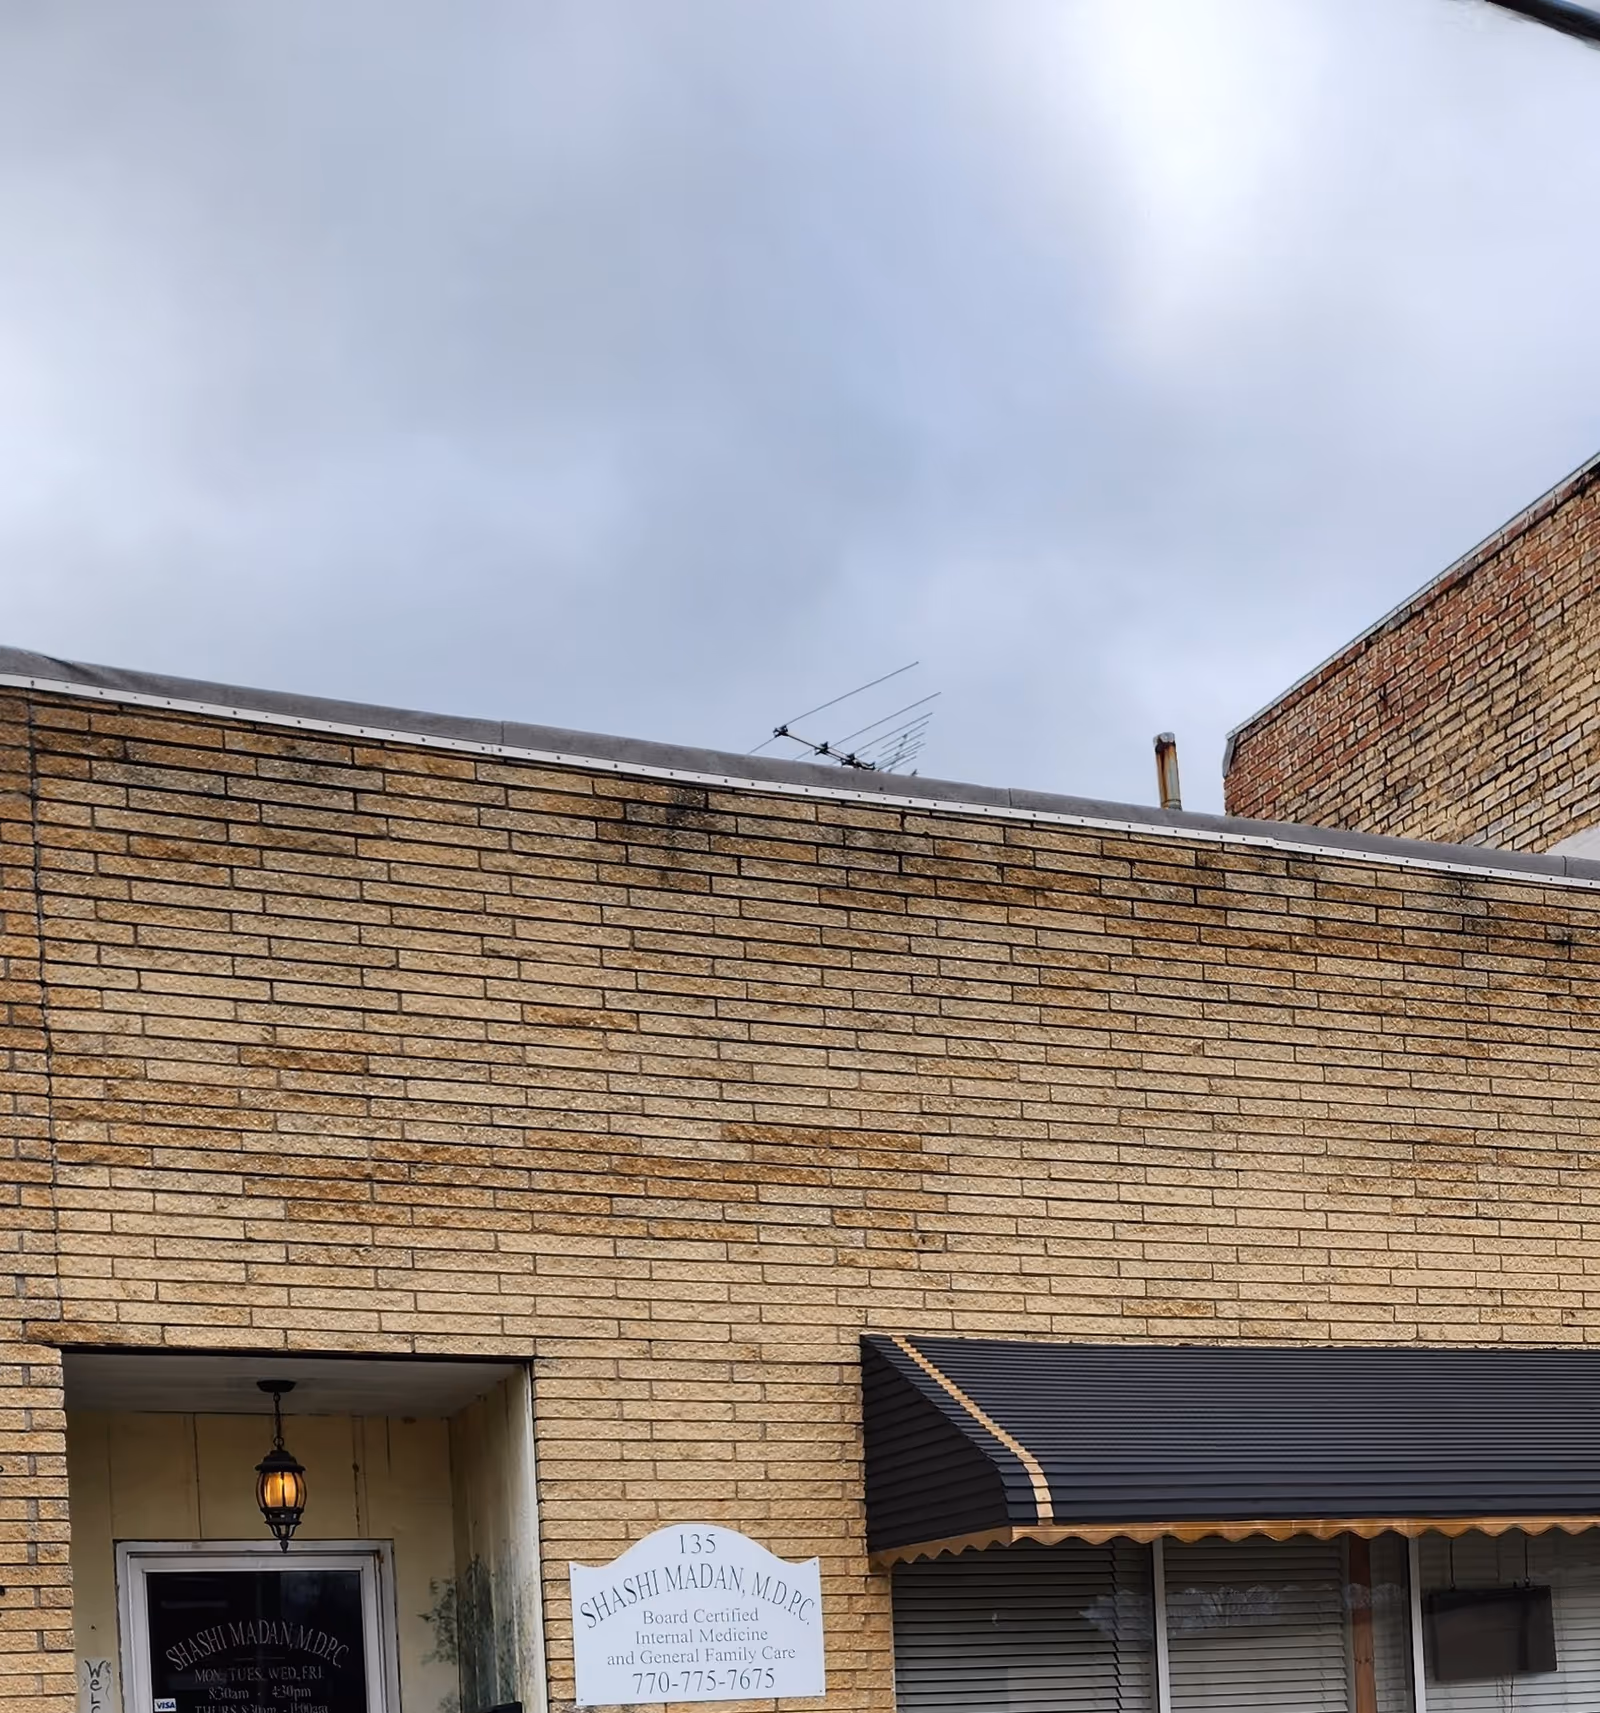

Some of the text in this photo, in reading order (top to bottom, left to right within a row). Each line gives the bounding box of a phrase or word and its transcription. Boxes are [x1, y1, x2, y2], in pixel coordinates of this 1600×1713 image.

[679, 1533, 716, 1554] 135
[580, 1568, 660, 1628] SHASHI
[664, 1562, 746, 1599] MADAN,
[643, 1607, 759, 1625] Board Certified
[165, 1624, 228, 1672] SHASHI
[228, 1618, 293, 1651] MADAN,
[635, 1627, 768, 1645] Internal Medicine
[607, 1645, 796, 1665] and General Family Care
[632, 1667, 775, 1695] 770-775-7675
[156, 1701, 176, 1709] VISA
